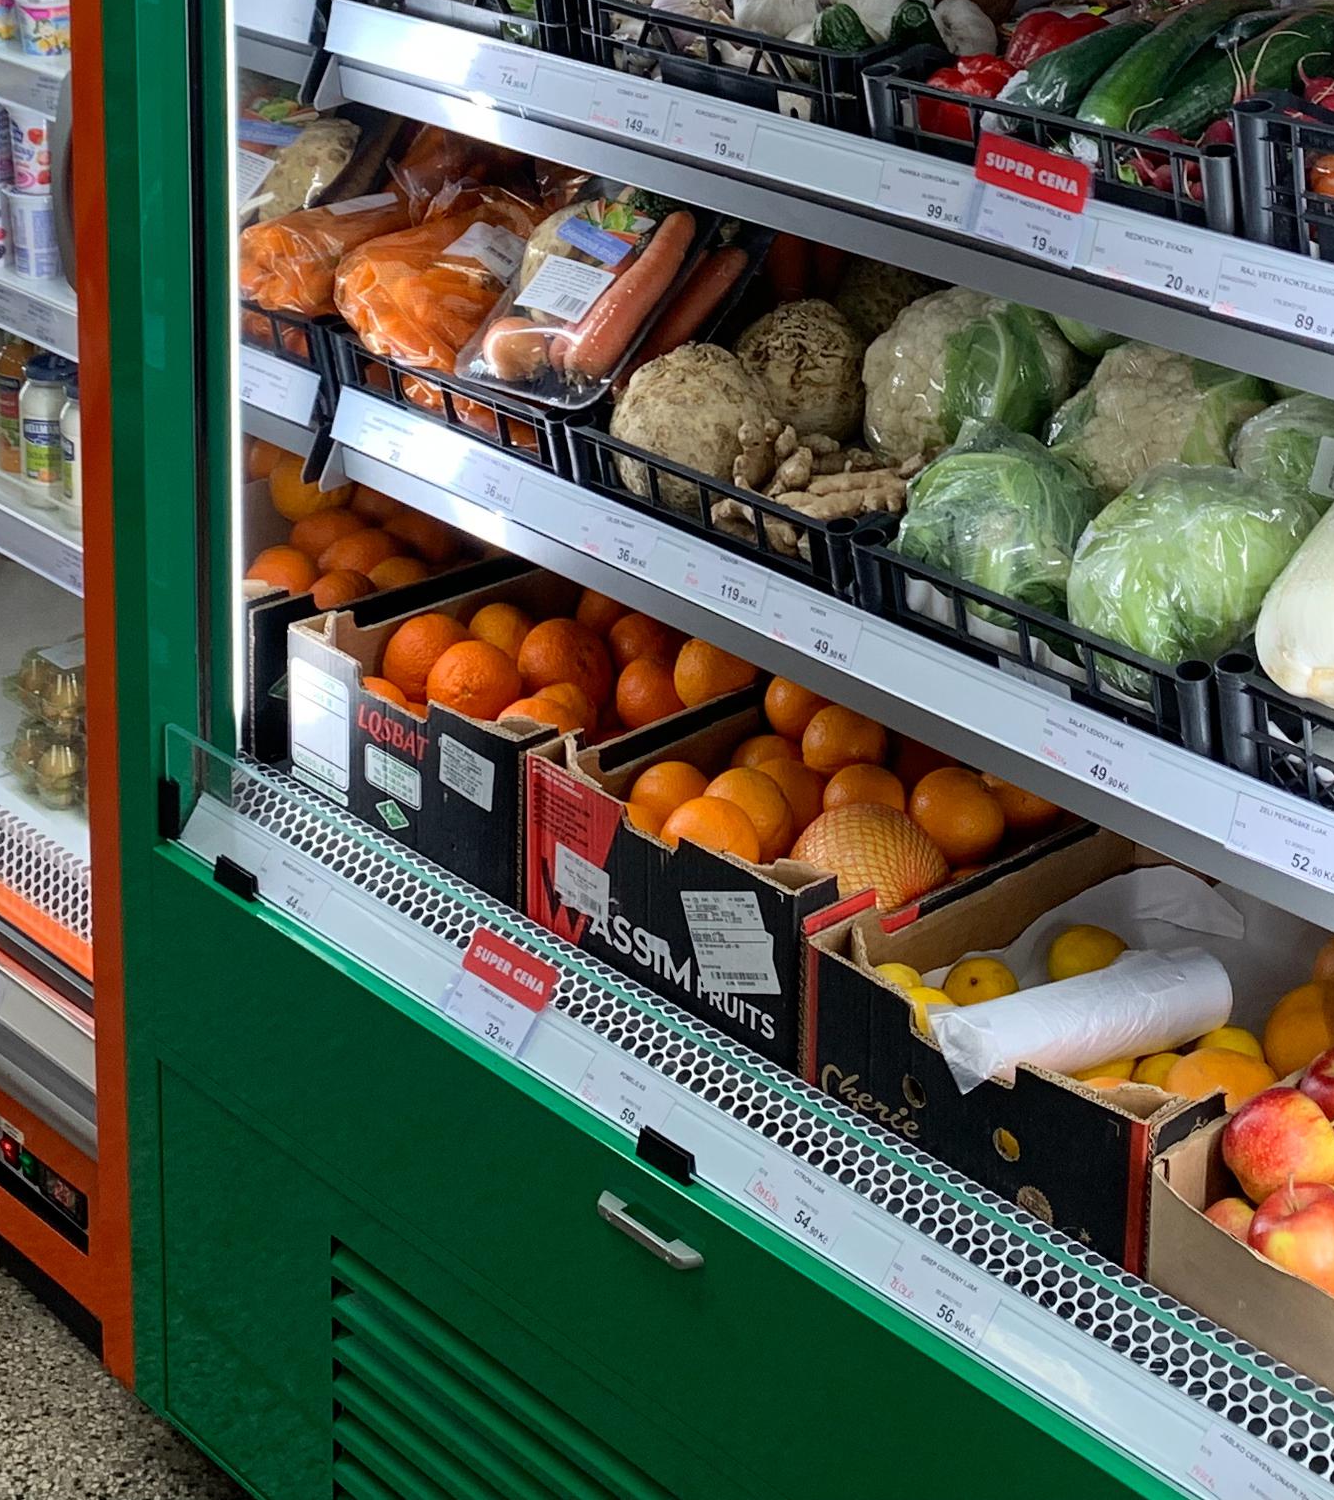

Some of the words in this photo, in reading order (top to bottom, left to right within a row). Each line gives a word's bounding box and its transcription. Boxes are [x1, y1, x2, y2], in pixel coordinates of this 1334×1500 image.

[984, 151, 1035, 182] SUPER
[1037, 169, 1079, 197] CENA
[1031, 234, 1058, 256] 19,90
[1164, 274, 1196, 296] 20,90
[1294, 312, 1328, 336] 89,90
[1089, 762, 1118, 789] 49,90
[1289, 852, 1323, 879] 52,90
[472, 944, 512, 978] SUPER
[512, 967, 546, 997] CENA
[695, 975, 778, 1041] FRUITS
[483, 1022, 506, 1046] 32,90
[793, 1209, 820, 1238] 54,90
[935, 1302, 965, 1333] 56,90
